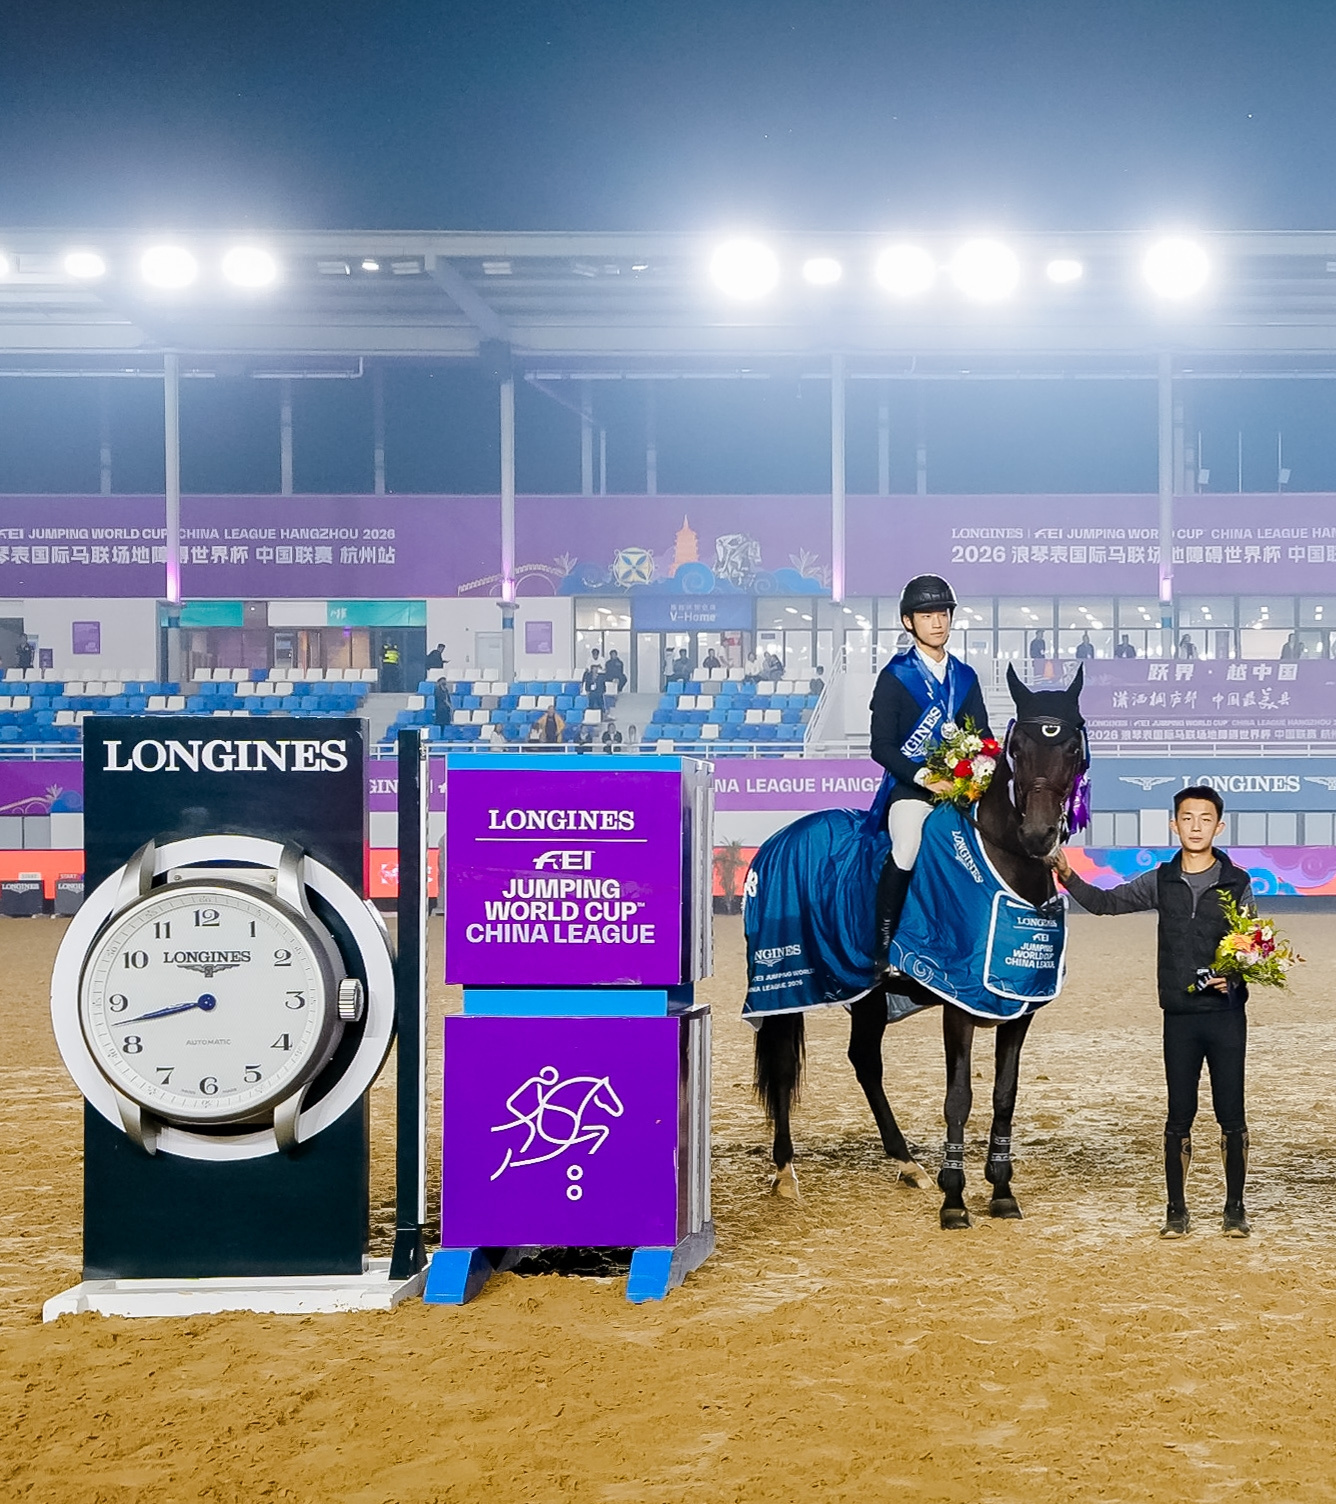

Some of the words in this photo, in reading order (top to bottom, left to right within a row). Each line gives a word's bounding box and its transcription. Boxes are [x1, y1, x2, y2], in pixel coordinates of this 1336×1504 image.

[28, 528, 89, 540] JUMPING
[90, 528, 140, 540] WORLD
[179, 528, 220, 540] CHINA
[224, 528, 276, 540] LEAGUE
[280, 528, 359, 540] HANGZHOU
[362, 528, 396, 540] 2026
[951, 527, 1024, 539] LONGINES
[1067, 528, 1126, 539] JUMPING
[1127, 528, 1175, 539] WOR
[1211, 528, 1252, 539] CHINA
[1257, 528, 1308, 539] LEAGUE
[255, 545, 333, 564] 中国联赛
[339, 545, 396, 564] 杭州站
[951, 545, 1006, 563] 2026
[900, 706, 942, 758] NGINES
[1088, 729, 1118, 740] 2026
[102, 739, 348, 772] LONGINES
[746, 778, 816, 793] LEAGUE
[821, 777, 883, 793] HANGZ
[1182, 775, 1301, 792] LONGINES
[488, 809, 635, 830] LONGINES
[533, 850, 596, 870] FEI
[502, 878, 620, 899] JUMPING
[193, 908, 220, 927] 12
[484, 901, 580, 921] WORLD
[153, 921, 171, 939] 11
[248, 921, 256, 937] 1
[466, 923, 549, 944] CHINA
[553, 924, 656, 944] LEAGUE
[123, 950, 149, 969] 10
[163, 951, 251, 963] LONGINES
[274, 949, 292, 967] 2
[754, 944, 802, 961] NGINES
[1005, 957, 1035, 968] CHINA
[109, 994, 128, 1013] 9
[285, 991, 306, 1010] 3
[122, 1036, 143, 1054] 8
[186, 1038, 232, 1046] AUTOMATIC
[270, 1033, 293, 1051] 4
[156, 1067, 175, 1085] 7
[243, 1064, 262, 1084] 5
[199, 1077, 218, 1095] 6
